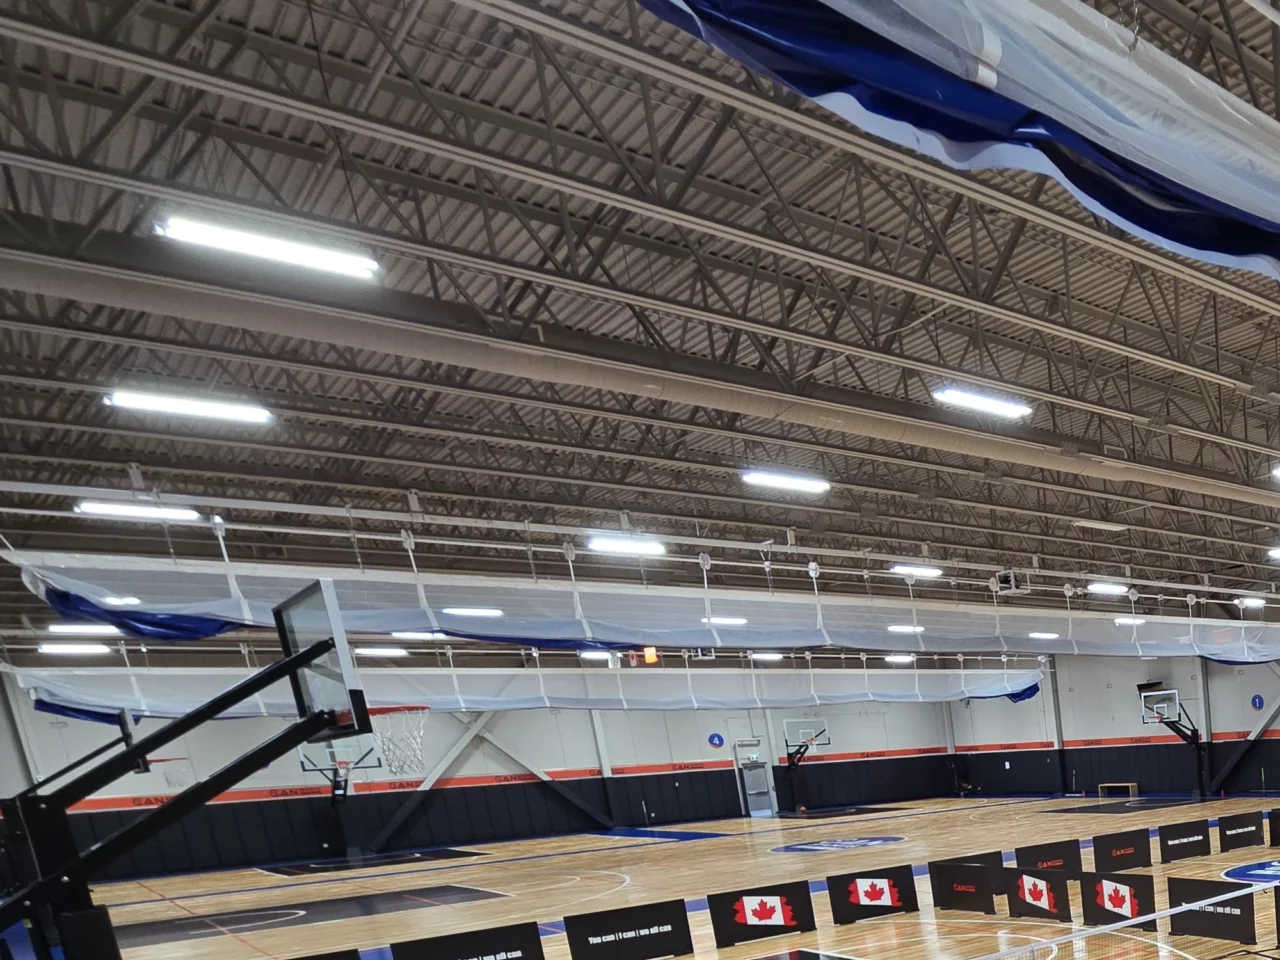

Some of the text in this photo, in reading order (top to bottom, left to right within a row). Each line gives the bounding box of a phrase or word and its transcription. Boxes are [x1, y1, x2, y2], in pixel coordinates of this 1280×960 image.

[1255, 698, 1260, 708] 1
[588, 937, 601, 945] You
[602, 934, 615, 942] can
[622, 931, 636, 939] can
[639, 928, 649, 936] we
[650, 926, 659, 934] all
[659, 924, 672, 932] can
[496, 952, 507, 960] all
[507, 950, 522, 959] can
